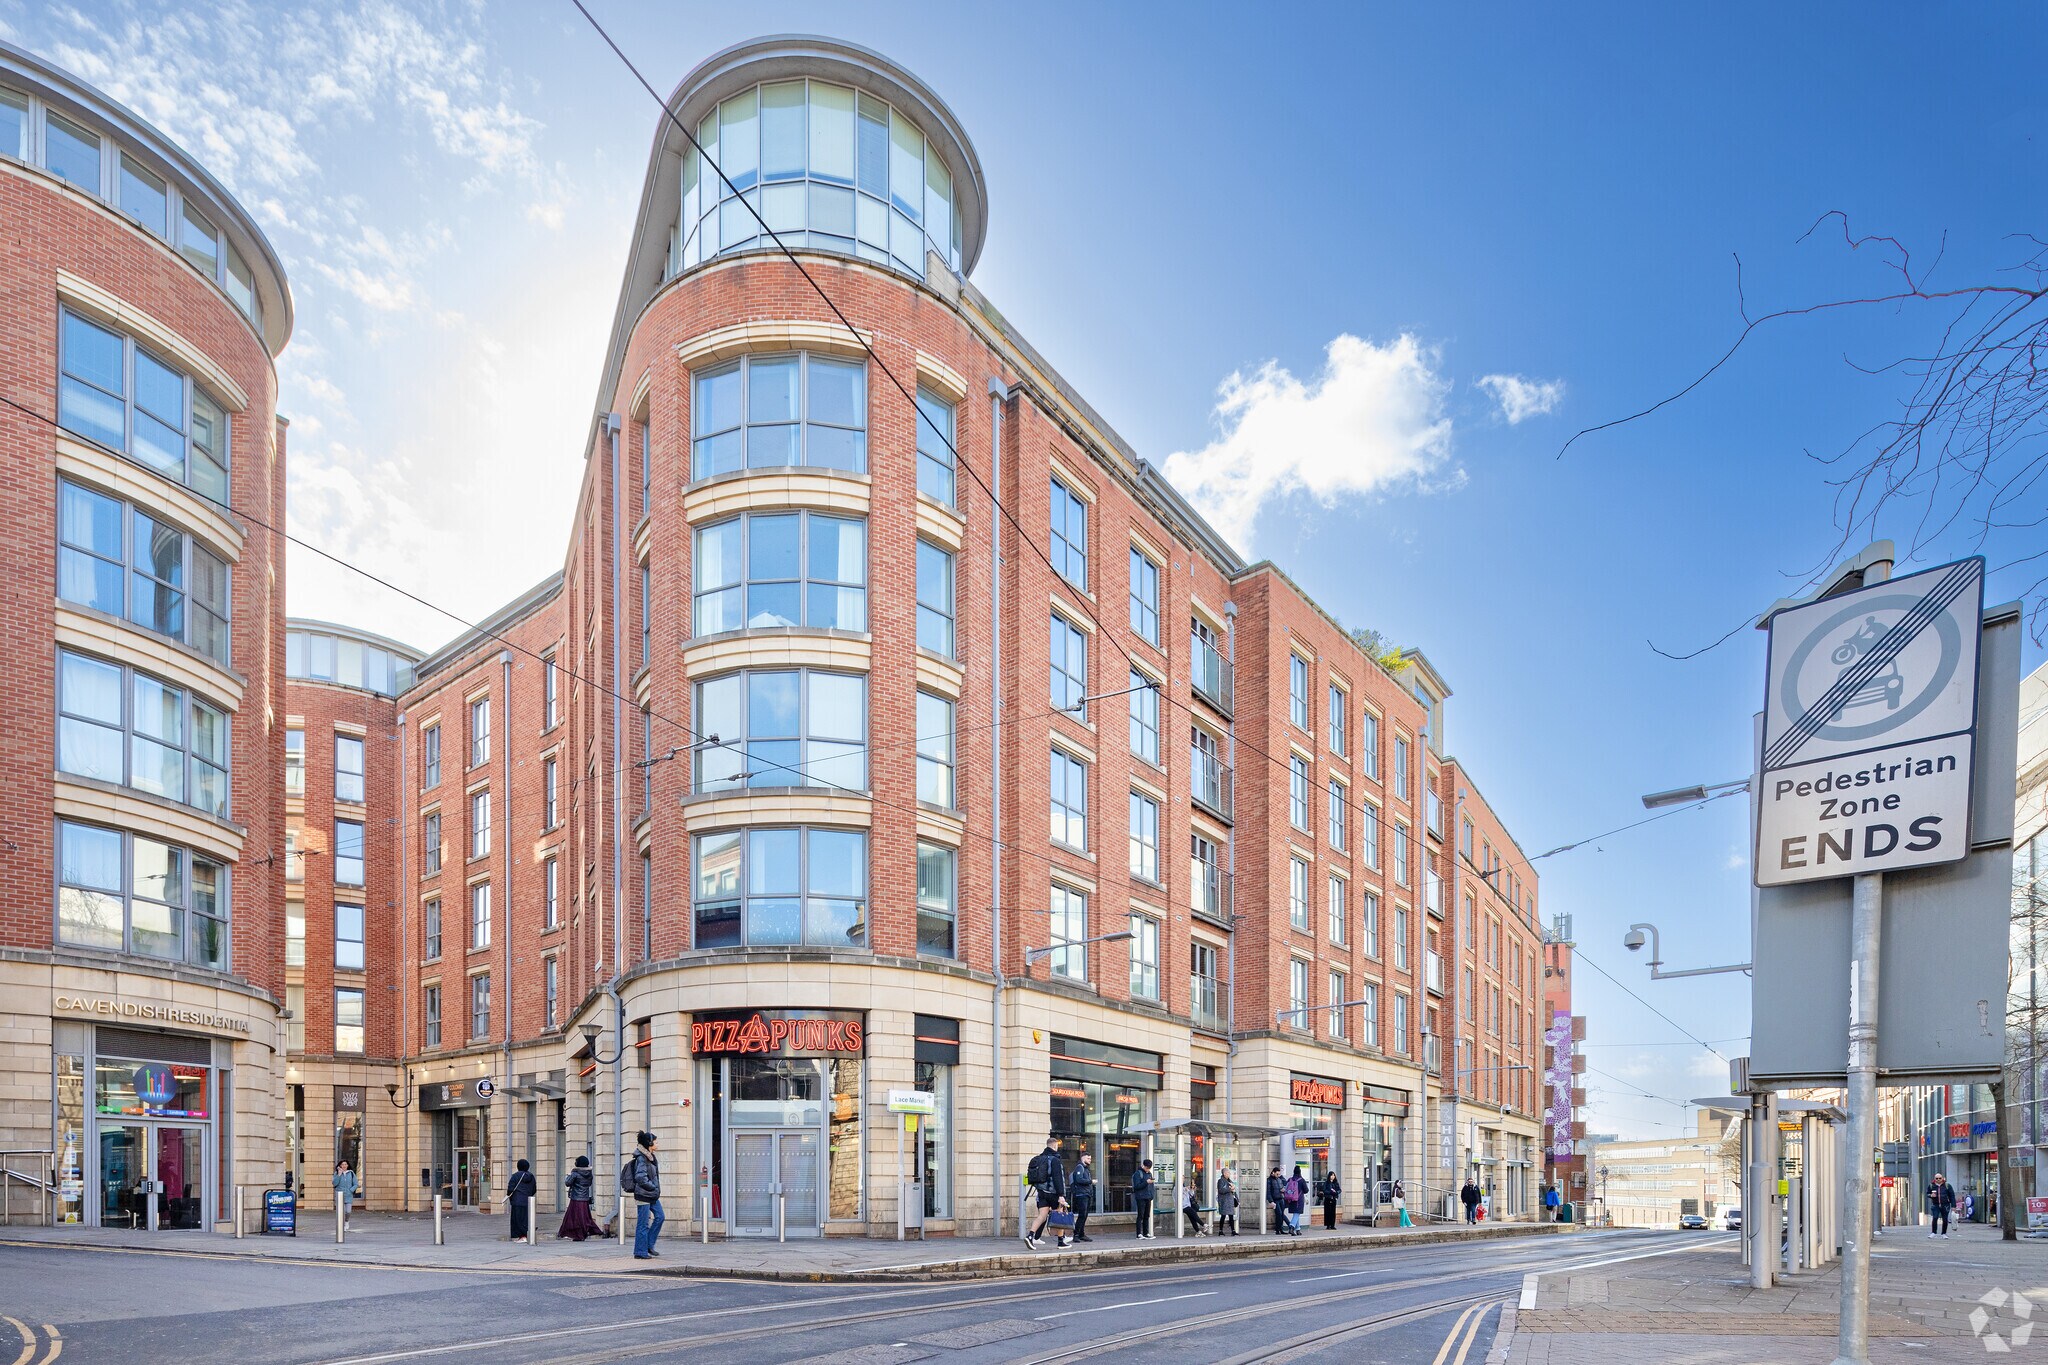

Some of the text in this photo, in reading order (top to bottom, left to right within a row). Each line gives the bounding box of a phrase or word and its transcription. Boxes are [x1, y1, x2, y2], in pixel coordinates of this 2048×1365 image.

[1775, 754, 1956, 801] Pedestrian
[1819, 793, 1901, 821] Zone
[1780, 816, 1943, 870] ENDS
[1442, 1125, 1451, 1167] HAIR
